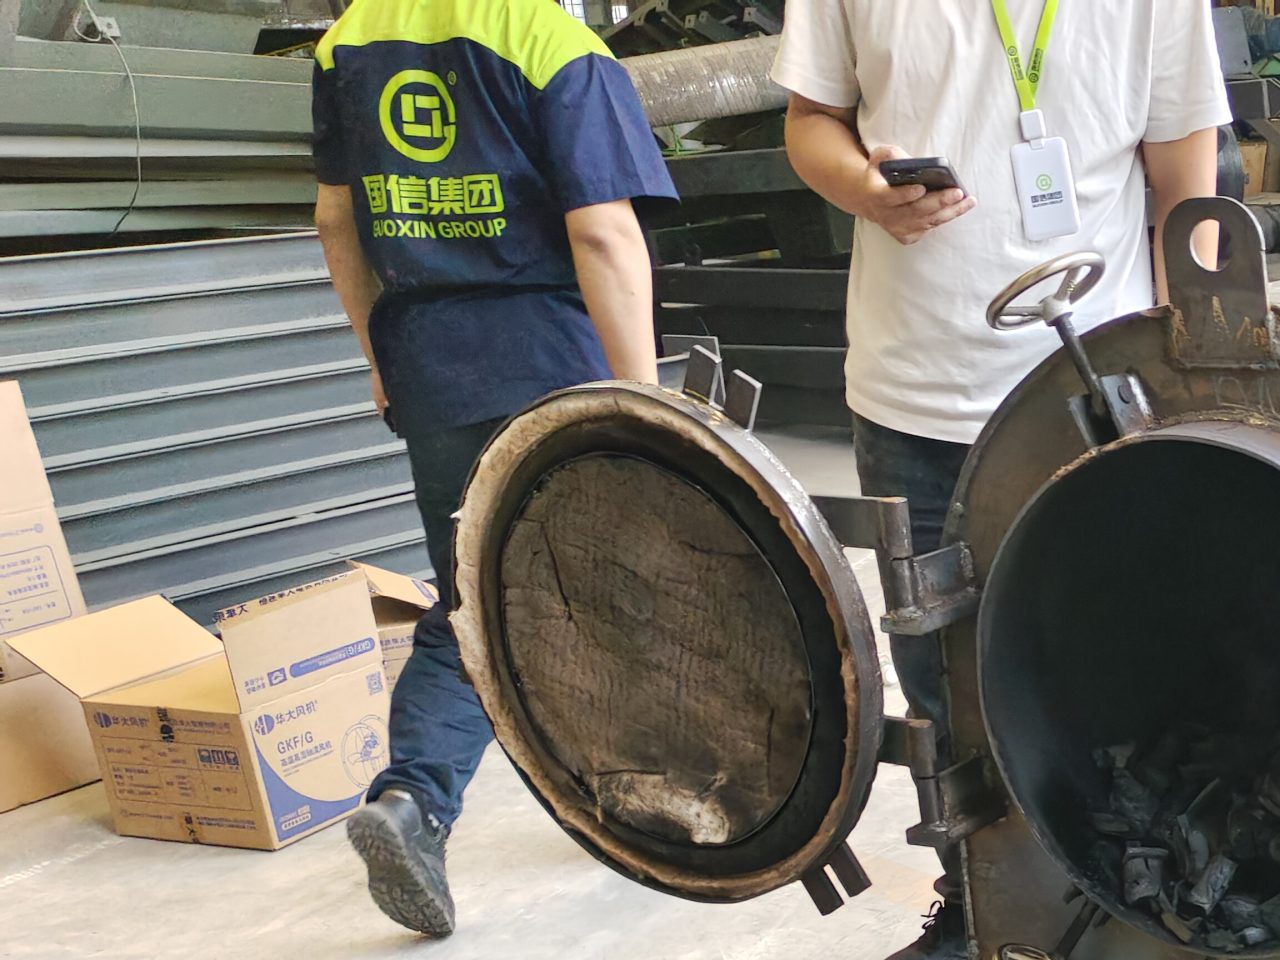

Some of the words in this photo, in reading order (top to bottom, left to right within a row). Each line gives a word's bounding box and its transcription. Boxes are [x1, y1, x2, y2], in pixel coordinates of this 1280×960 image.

[361, 173, 505, 215] 国信集团
[437, 217, 507, 239] GROUP
[275, 701, 316, 725] 华大风机
[277, 731, 314, 754] GKF/G
